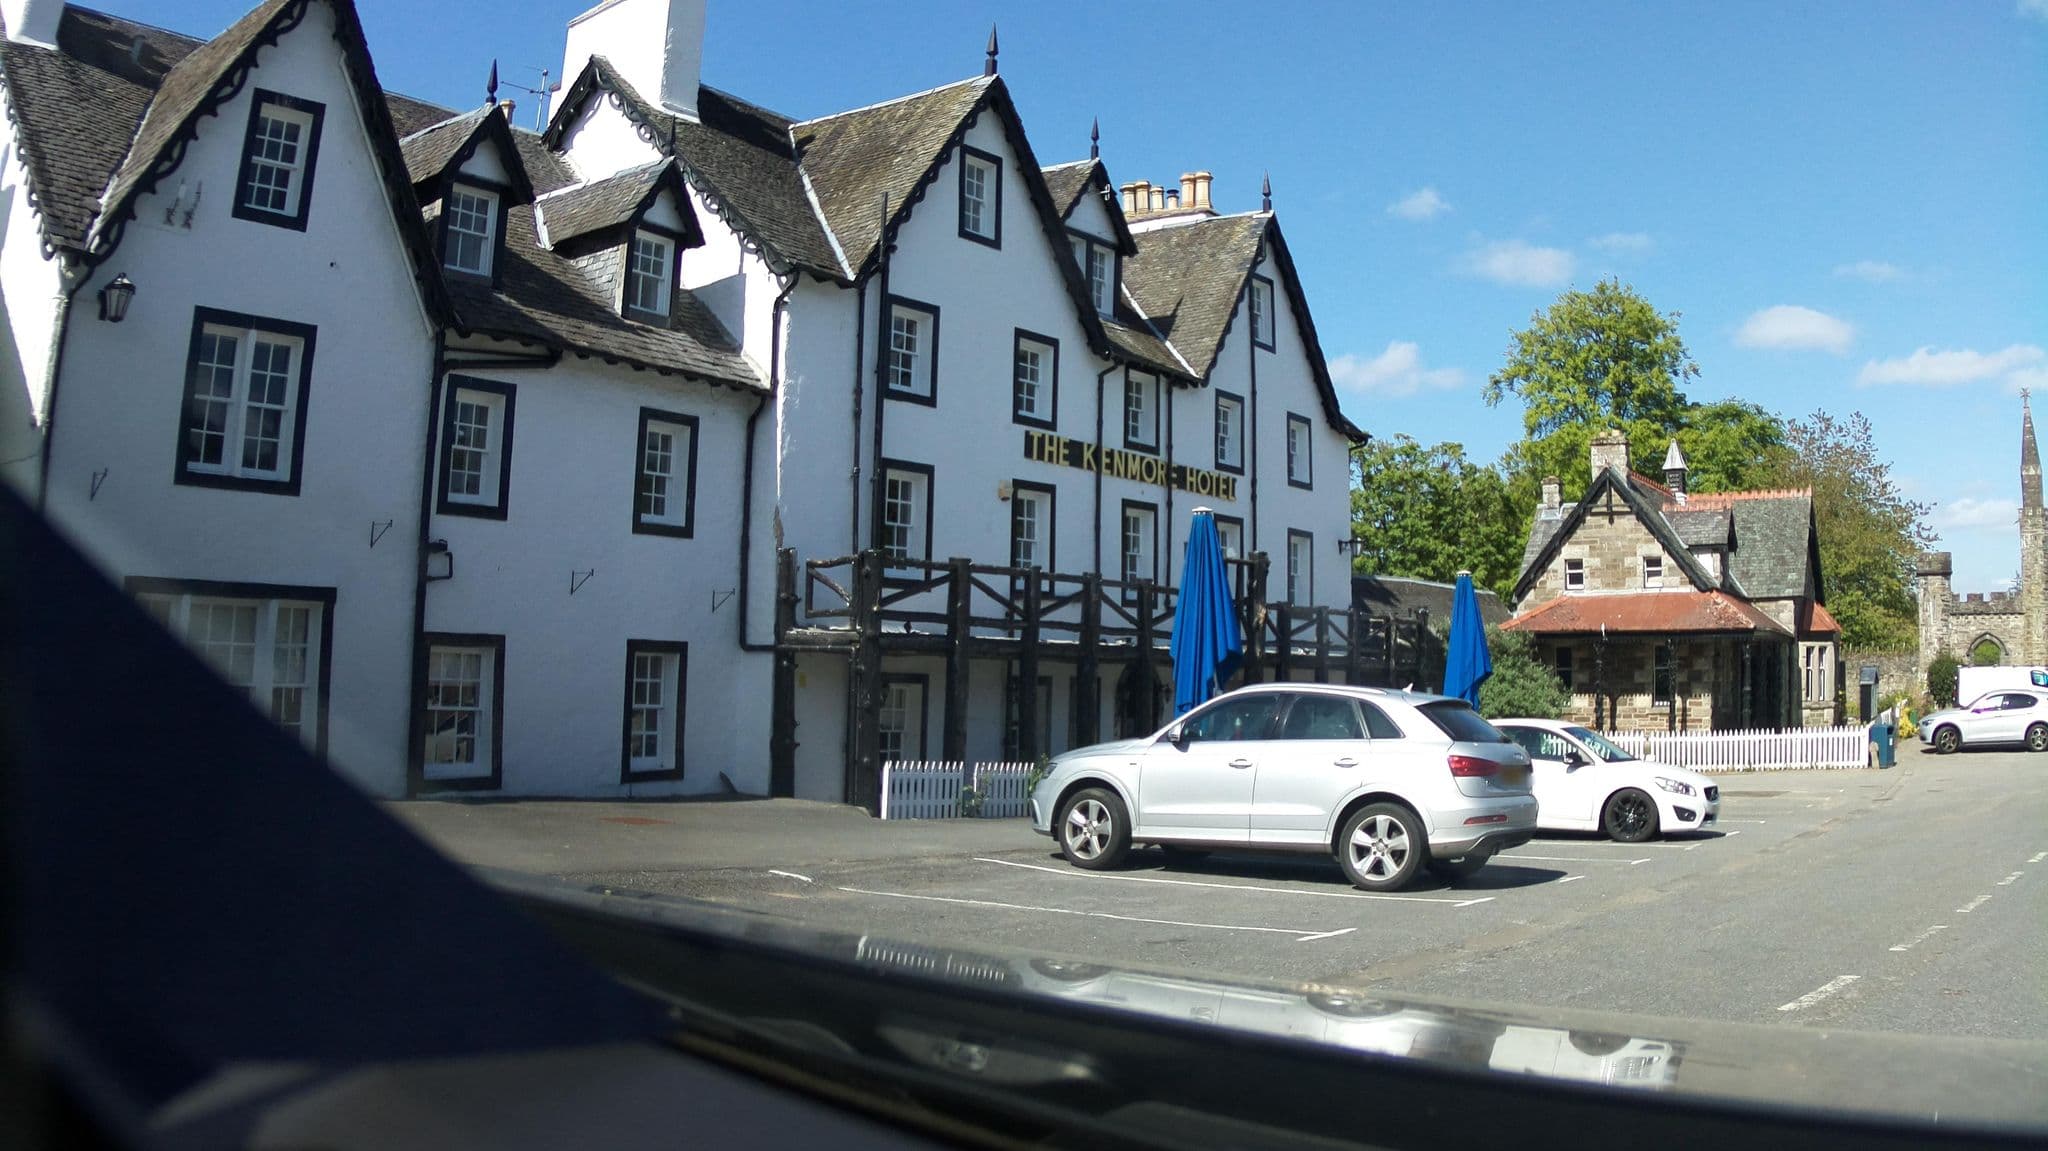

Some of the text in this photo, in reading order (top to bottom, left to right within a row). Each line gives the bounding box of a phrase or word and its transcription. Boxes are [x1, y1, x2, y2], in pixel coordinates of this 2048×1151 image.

[1029, 431, 1237, 501] THE KENMORE HOTEL
